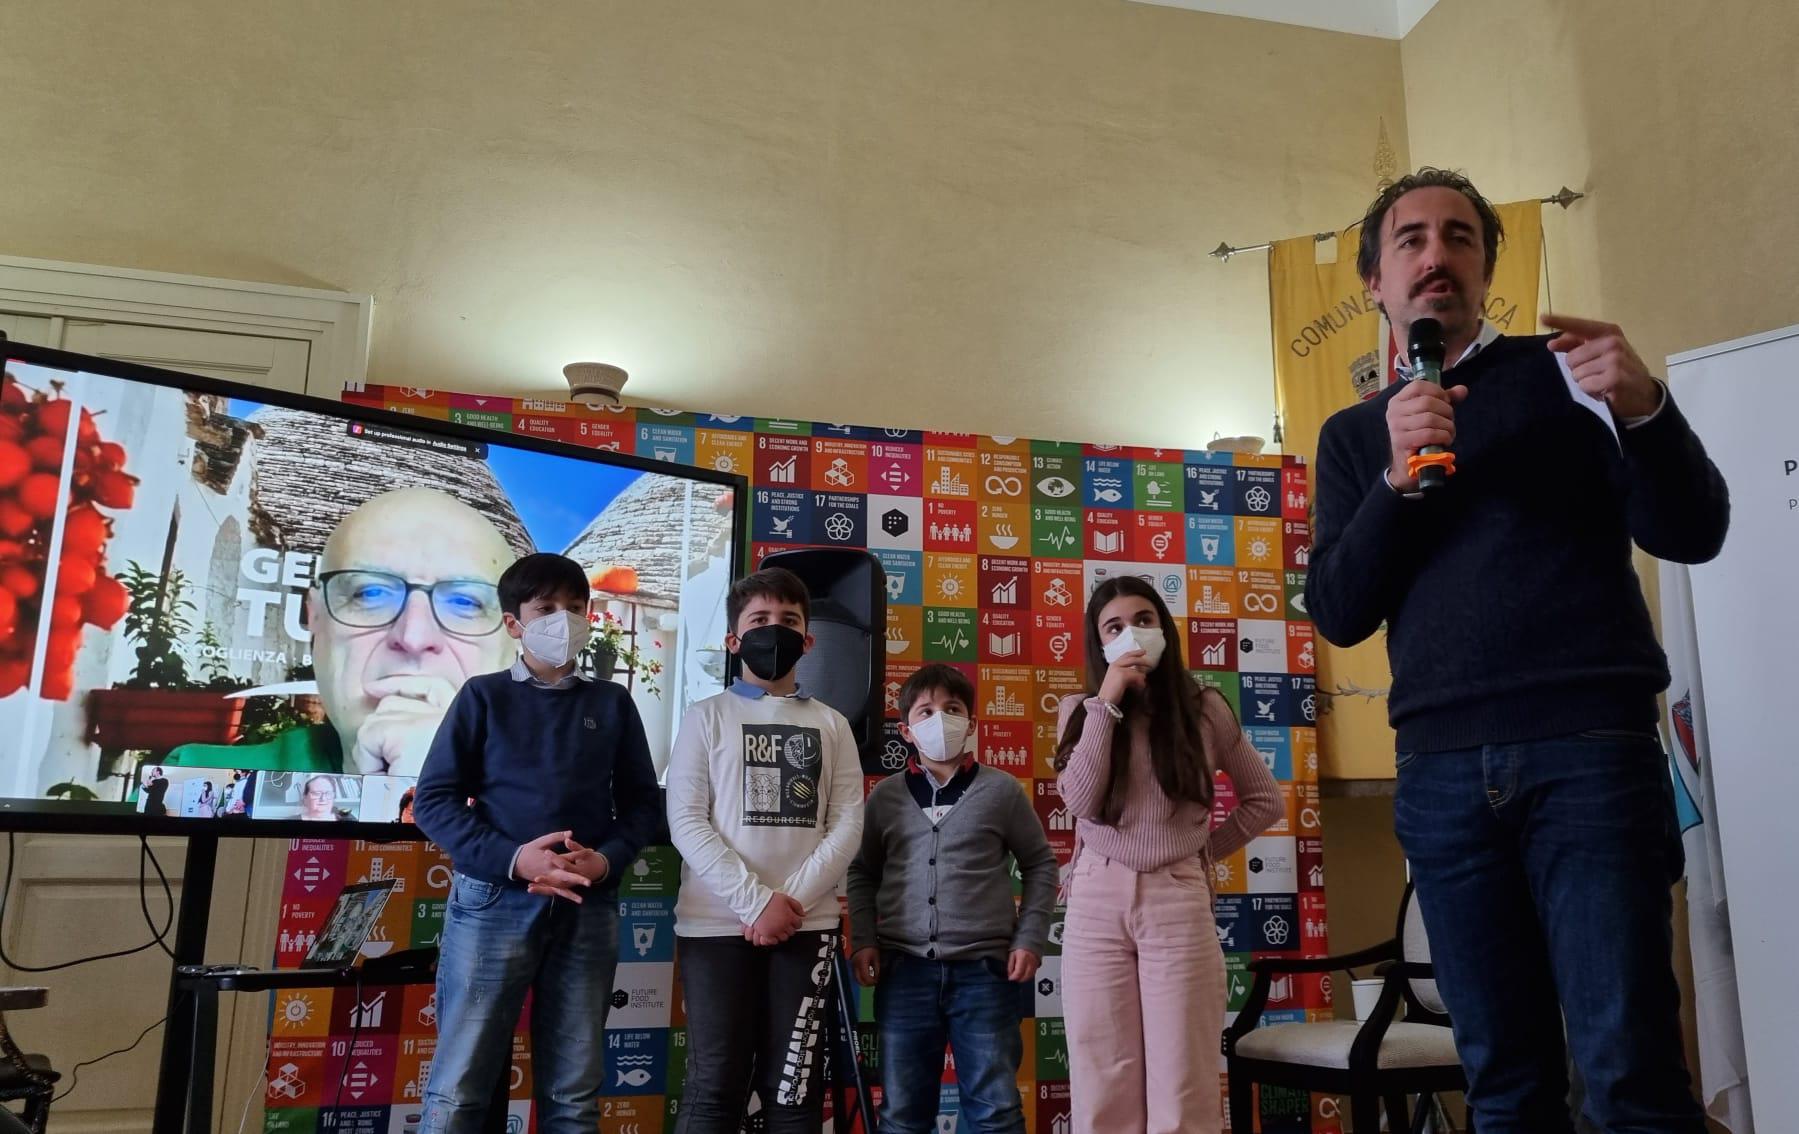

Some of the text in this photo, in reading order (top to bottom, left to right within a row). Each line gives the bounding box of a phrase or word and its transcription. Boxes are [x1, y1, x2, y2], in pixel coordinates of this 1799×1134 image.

[1290, 289, 1378, 358] COMUNE
[455, 413, 462, 426] 3
[518, 418, 525, 430] 4
[580, 423, 588, 435] 5
[641, 428, 648, 440] 6
[381, 432, 411, 442] professional
[432, 440, 447, 448] Audio
[447, 442, 467, 452] Settings
[701, 433, 706, 444] 7
[759, 437, 766, 448] 8
[816, 440, 822, 452] 9
[872, 445, 882, 457] 10
[926, 449, 935, 461] 11
[981, 453, 990, 465] 12
[1034, 456, 1044, 468] 13
[1085, 460, 1095, 472] 14
[1136, 464, 1146, 476] 15
[1186, 467, 1197, 478] 16
[1236, 470, 1246, 481] 17
[1286, 472, 1291, 483] 1
[757, 491, 768, 503] 16
[815, 494, 826, 507] 17
[928, 503, 933, 514] 1
[982, 506, 987, 517] 2
[1035, 509, 1042, 520] 3
[1088, 512, 1094, 523] 4
[1139, 514, 1145, 526] 5
[1189, 518, 1195, 528] 6
[1239, 520, 1244, 530] 7
[1285, 522, 1291, 533] 8
[757, 547, 764, 559] 4
[928, 556, 933, 568] 7
[982, 559, 988, 570] 8
[1034, 561, 1041, 573] 9
[1189, 569, 1197, 580] 11
[1238, 571, 1248, 582] 12
[1286, 574, 1295, 585] 13
[927, 611, 934, 622] 3
[982, 613, 989, 625] 4
[1036, 615, 1042, 628] 5
[1192, 622, 1198, 633] 8
[1289, 625, 1295, 637] 9
[982, 669, 990, 681] 11
[1035, 670, 1046, 682] 12
[1242, 676, 1252, 688] 16
[1291, 678, 1300, 689] 17
[984, 725, 988, 736] 1
[1037, 726, 1043, 737] 2
[745, 734, 783, 763] R&F
[1038, 783, 1044, 795] 8
[1296, 786, 1304, 797] 12
[1298, 841, 1304, 853] 8
[620, 902, 626, 916] 6
[1252, 898, 1262, 910] 17
[1304, 897, 1307, 909] 1
[283, 904, 287, 919] 1
[418, 904, 426, 917] 3
[1040, 1022, 1047, 1036] 3
[608, 1034, 620, 1049] 14
[673, 1032, 685, 1046] 15
[331, 1041, 346, 1056] 10
[403, 1040, 414, 1054] 11
[1040, 1086, 1047, 1099] 8
[604, 1102, 611, 1117] 2
[670, 1100, 677, 1114] 3
[1262, 1098, 1308, 1115] SHAPER
